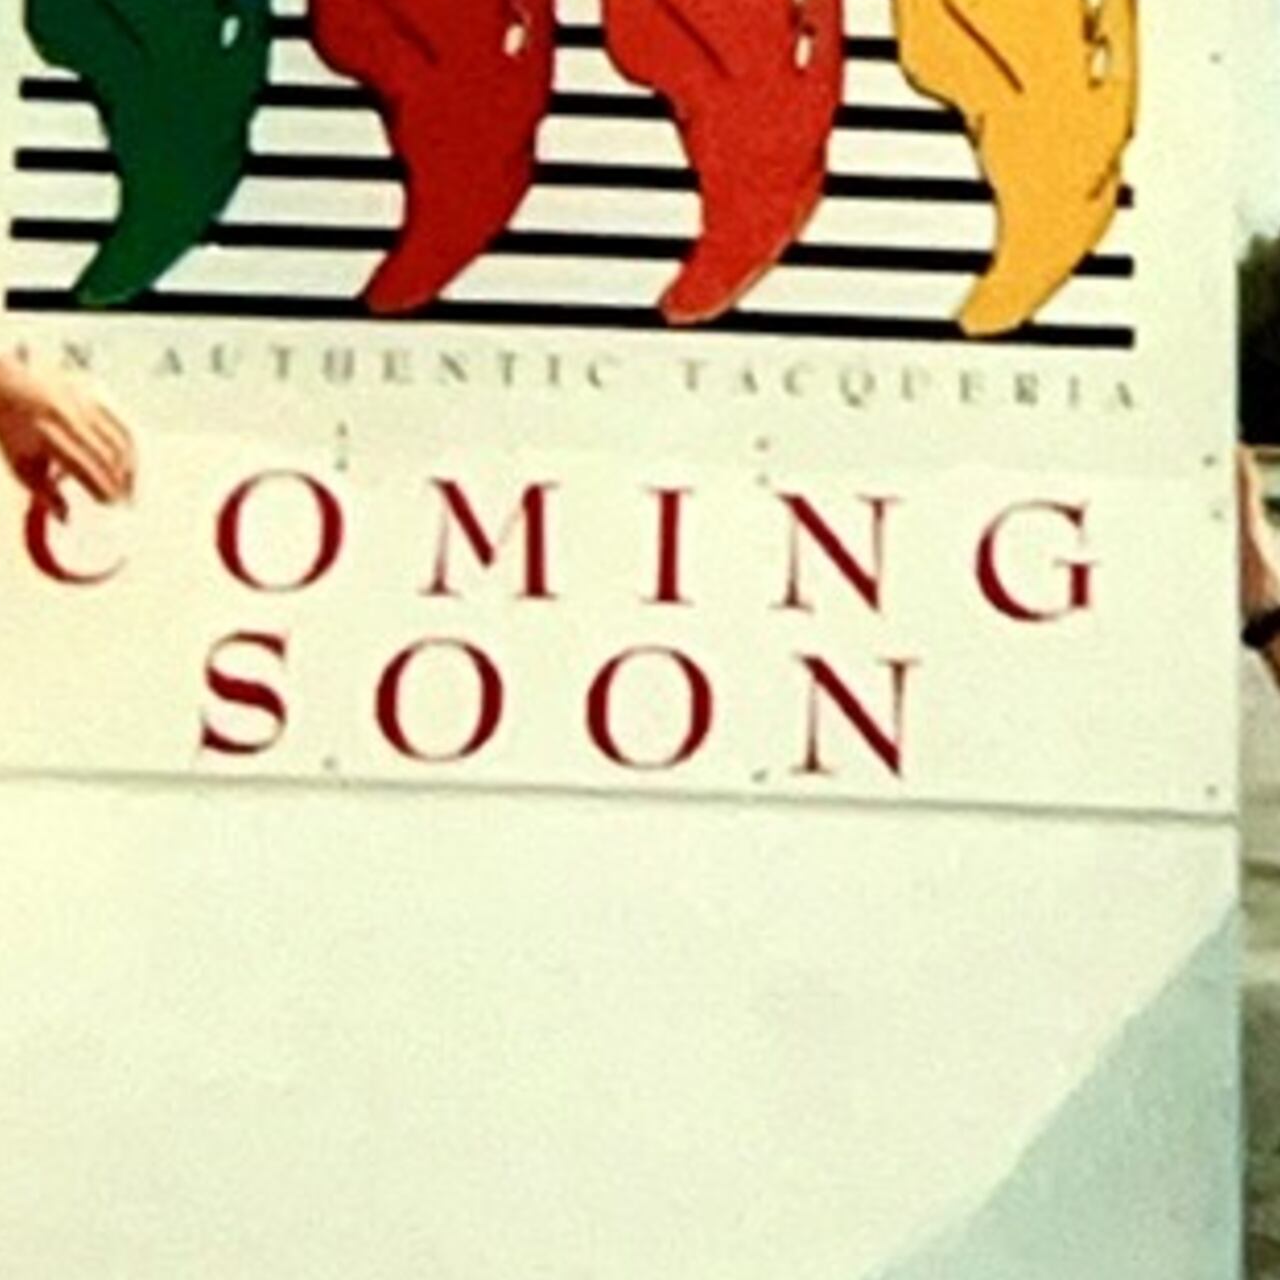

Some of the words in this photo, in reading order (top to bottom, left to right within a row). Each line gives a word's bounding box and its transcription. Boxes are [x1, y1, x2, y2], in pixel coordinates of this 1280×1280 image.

[153, 342, 623, 393] AUTHENTIC
[680, 356, 1138, 410] TACQUERIA
[22, 465, 1098, 625] COMING
[197, 629, 920, 781] SOON
